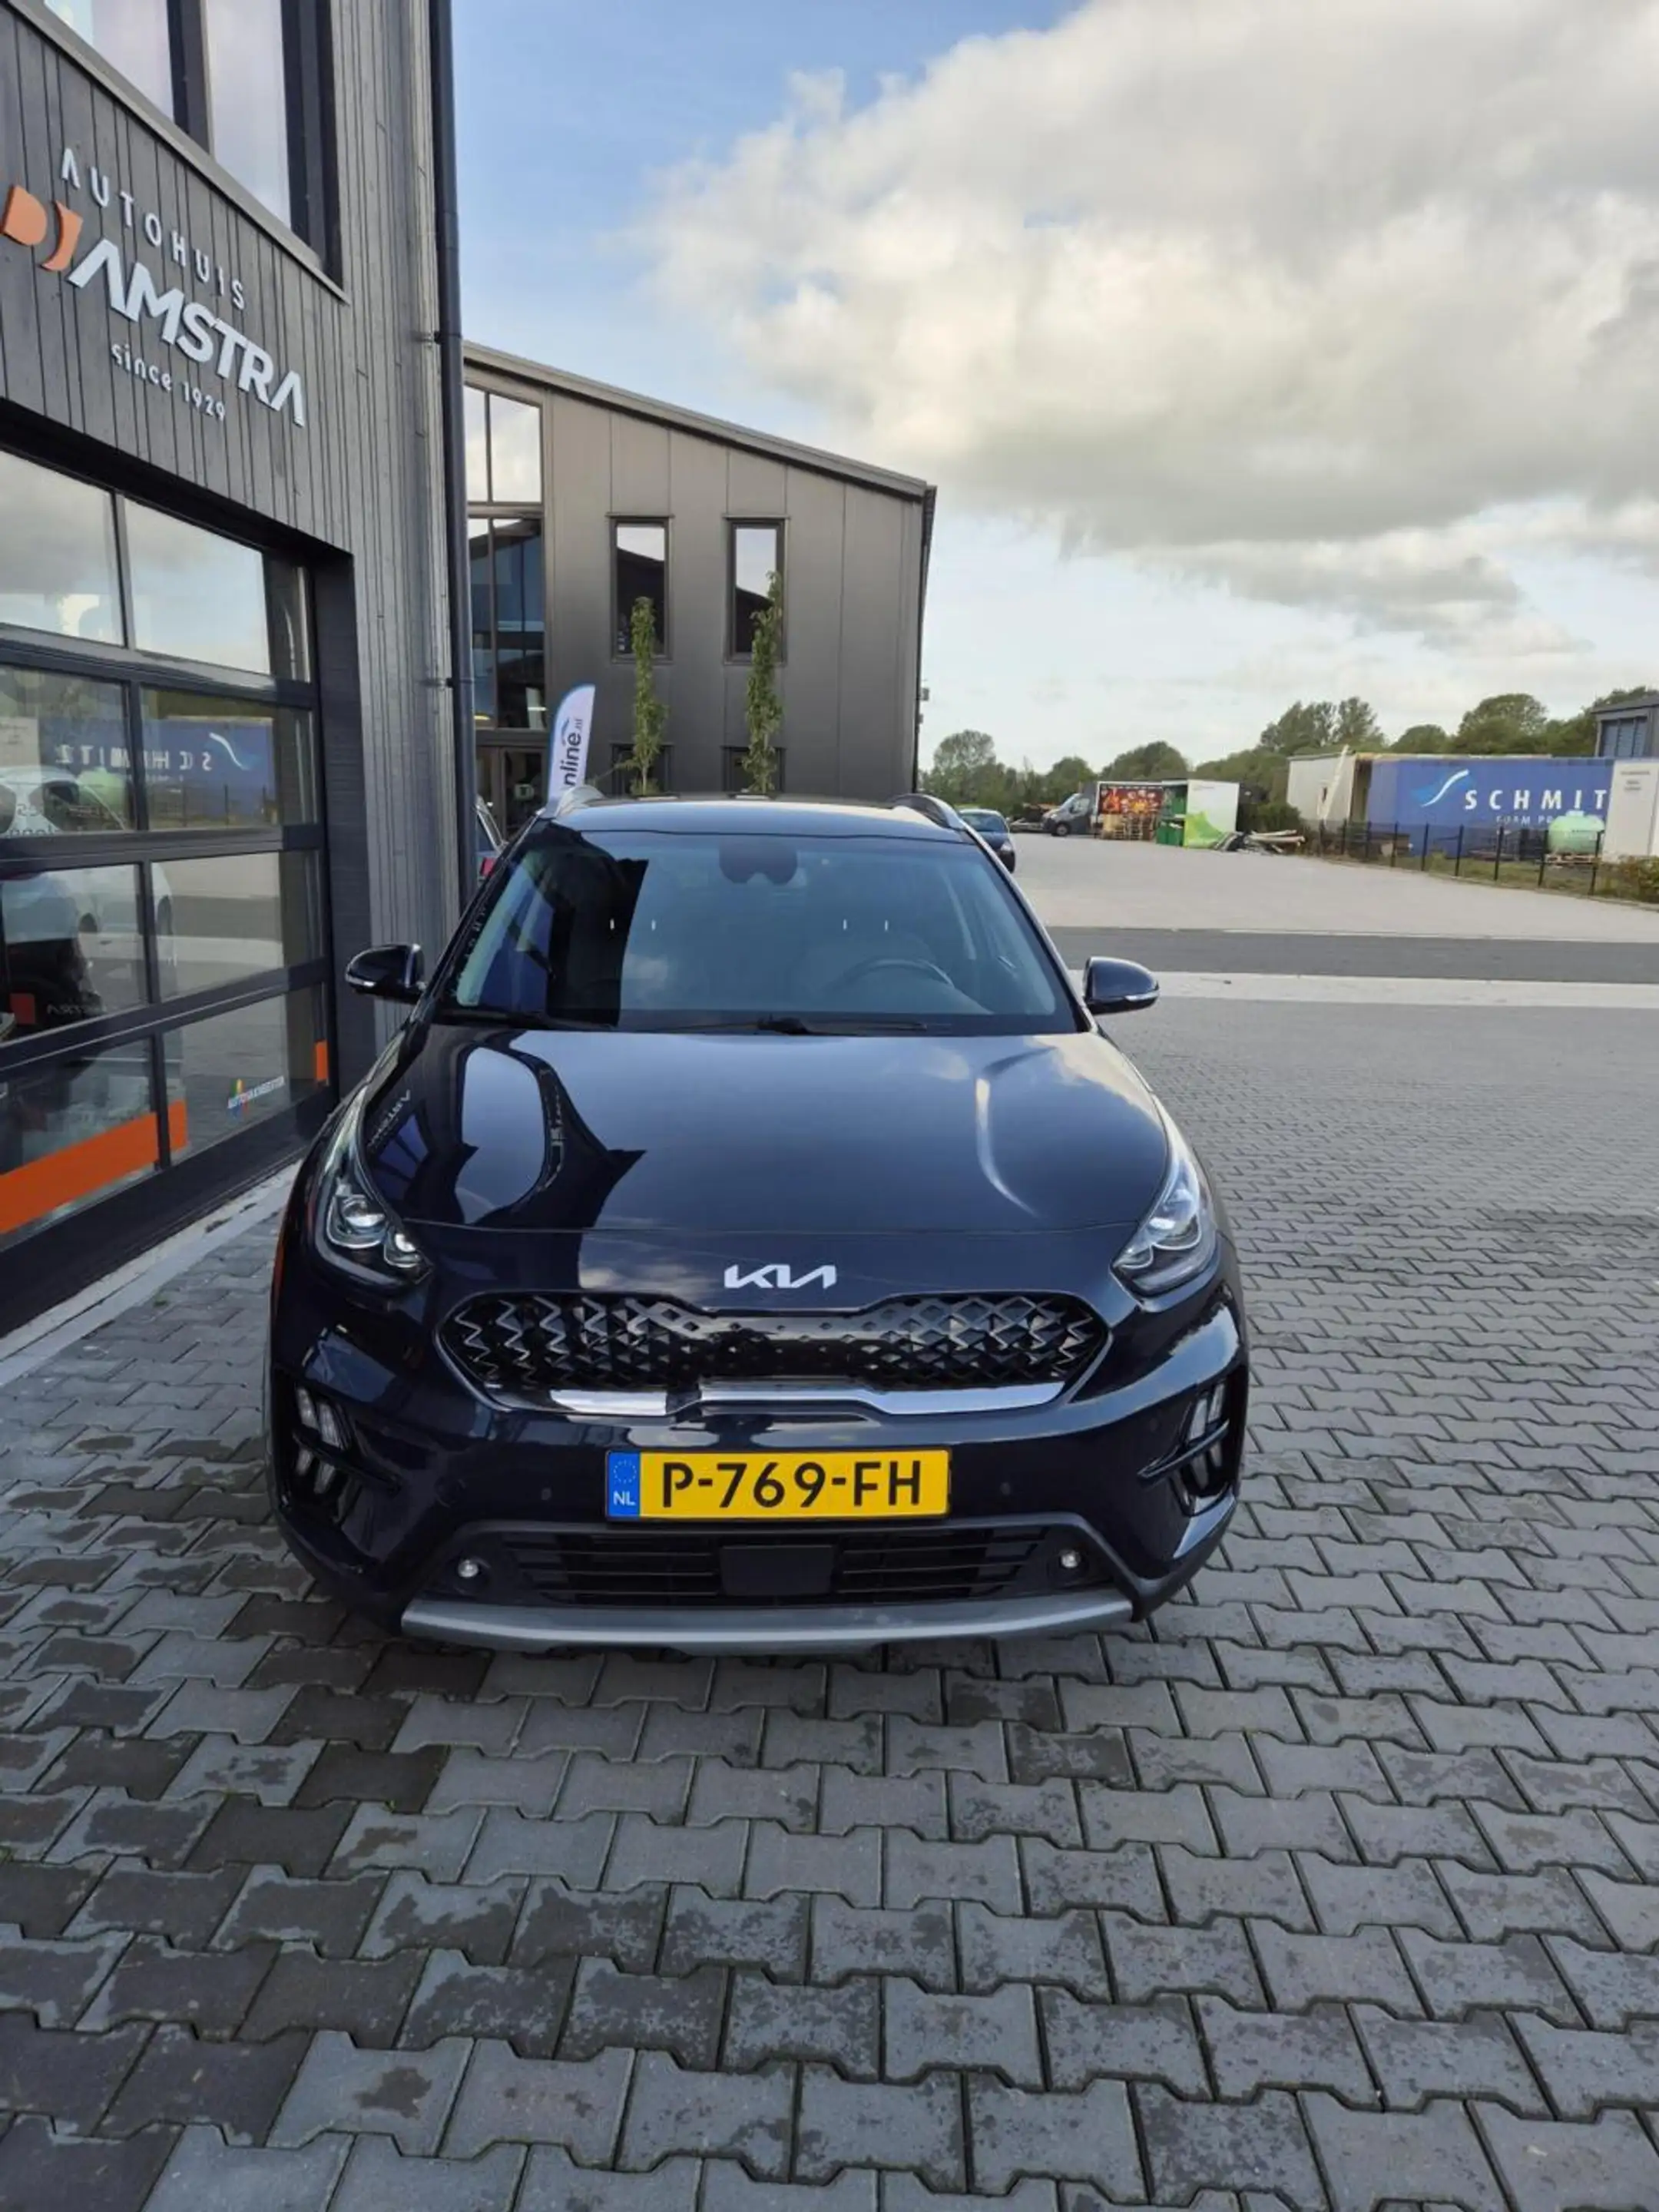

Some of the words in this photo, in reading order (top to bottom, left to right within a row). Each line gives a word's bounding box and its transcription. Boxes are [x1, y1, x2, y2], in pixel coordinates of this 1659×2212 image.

[61, 147, 246, 310] AUTOHUIS
[111, 343, 173, 392] since
[181, 381, 226, 422] 1929
[1465, 789, 1608, 810] SCHMIT
[724, 1263, 837, 1290] KIA
[613, 1491, 636, 1506] NL
[663, 1460, 921, 1508] P-769-FH
